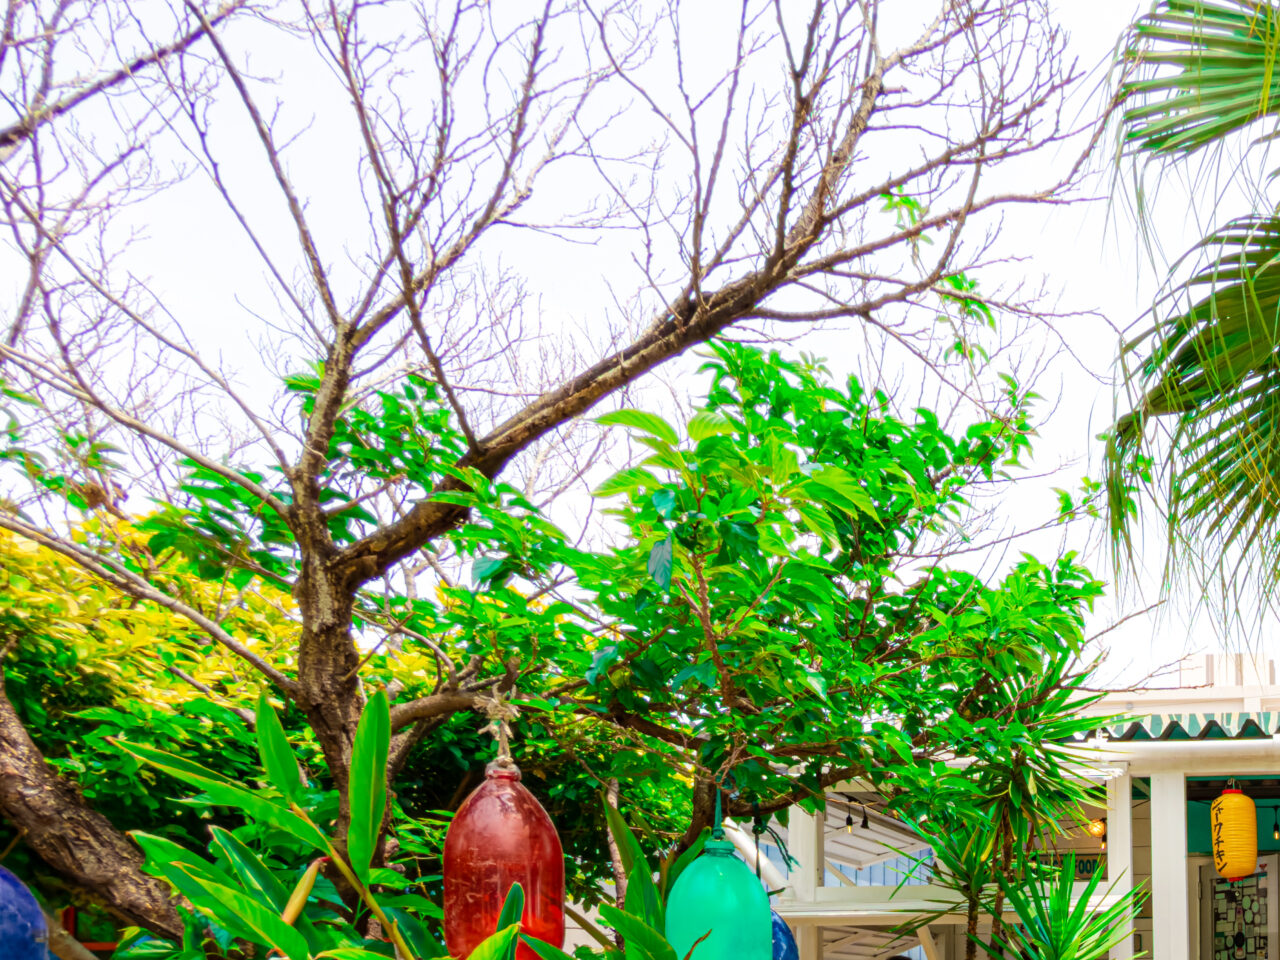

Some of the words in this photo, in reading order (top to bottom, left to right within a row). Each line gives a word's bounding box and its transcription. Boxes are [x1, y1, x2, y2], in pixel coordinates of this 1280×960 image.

[1211, 799, 1228, 873] ジャークチキン
